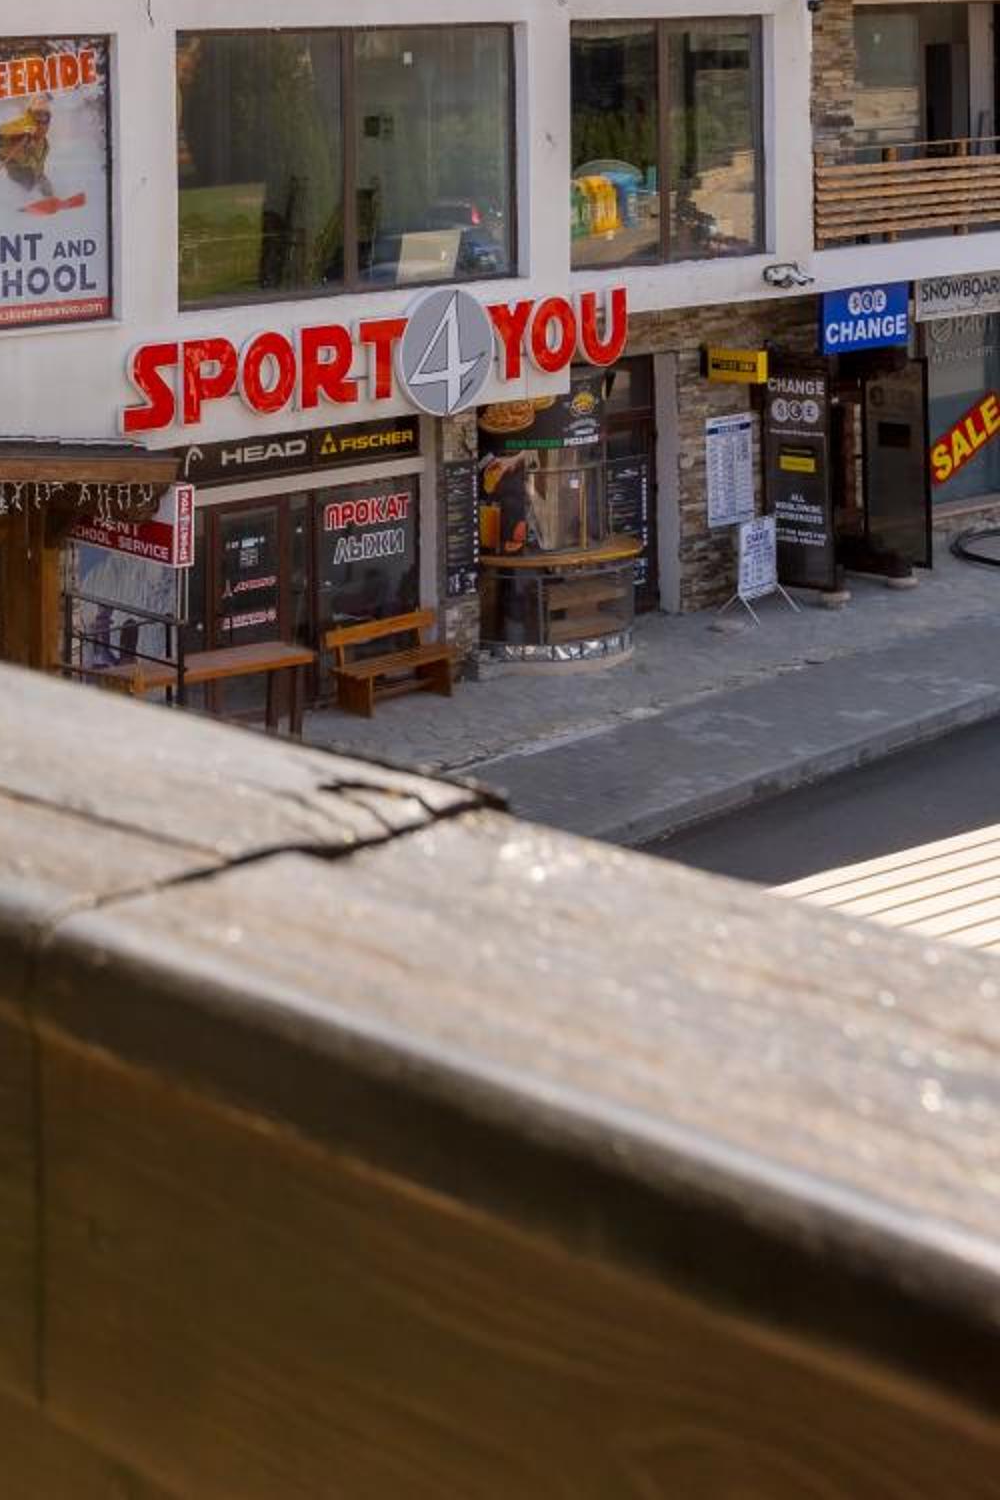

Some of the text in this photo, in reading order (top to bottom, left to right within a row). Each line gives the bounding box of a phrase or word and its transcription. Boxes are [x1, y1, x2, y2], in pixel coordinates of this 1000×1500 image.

[53, 240, 97, 258] AND
[825, 314, 907, 344] CHANGE
[122, 287, 629, 434] SPORT 4 YOU
[767, 377, 824, 395] CHANGE
[340, 429, 413, 451] FISCHER
[931, 395, 1000, 480] SALE
[222, 439, 307, 466] HEAD
[324, 492, 410, 531] ПРОКАТ
[93, 515, 140, 537] RENT
[118, 535, 169, 560] SERVICE
[333, 528, 405, 565] ЛЫЖИ
